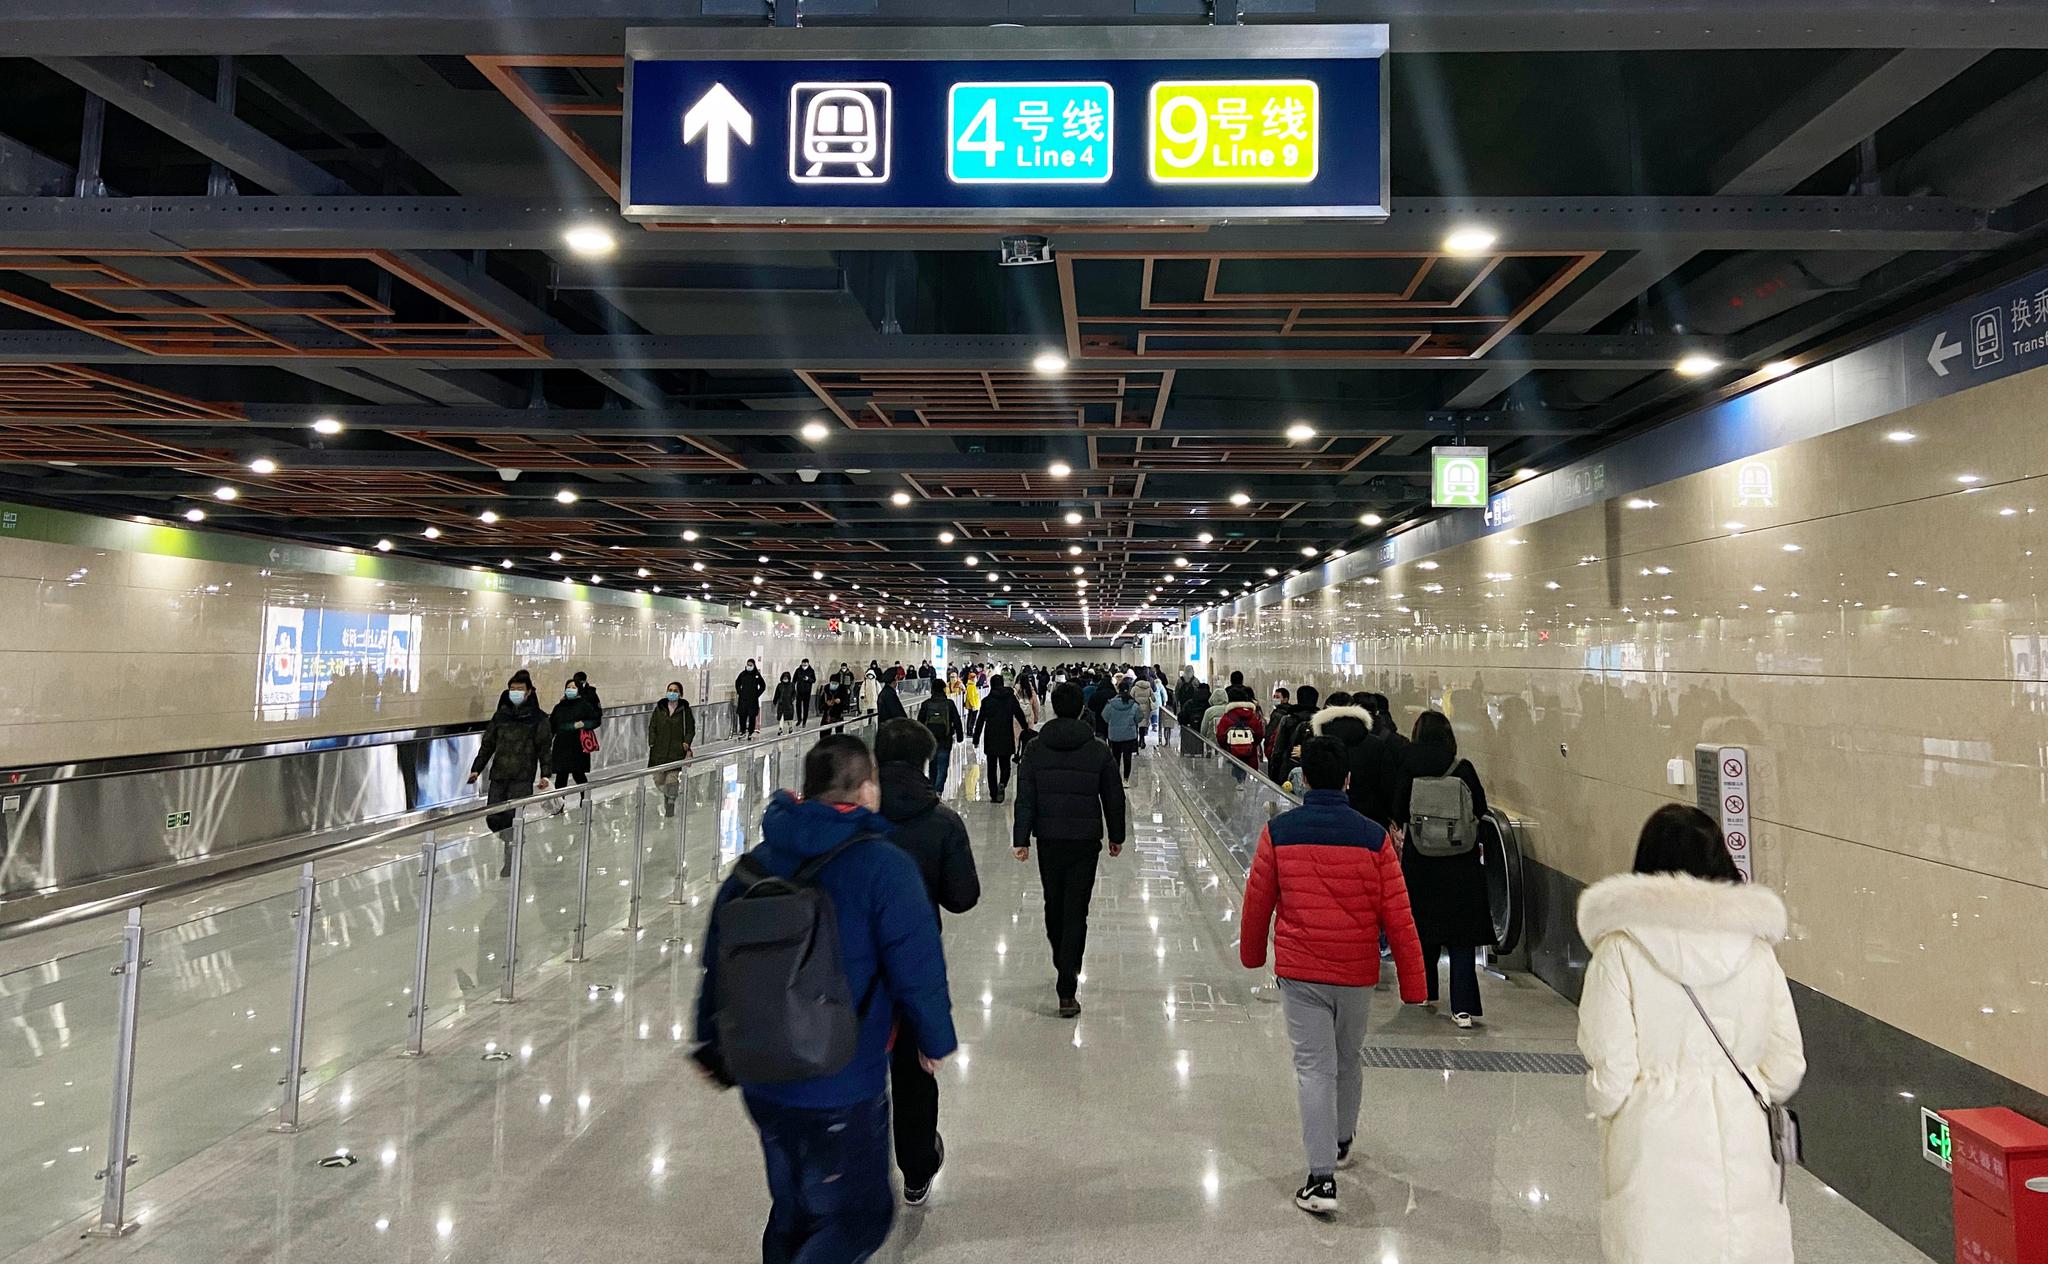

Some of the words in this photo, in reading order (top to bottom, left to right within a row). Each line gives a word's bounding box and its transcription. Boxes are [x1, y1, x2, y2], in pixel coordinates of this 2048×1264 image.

[1017, 145, 1076, 167] Line
[1080, 145, 1095, 167] 4
[1212, 144, 1275, 167] Line
[1282, 143, 1299, 167] 9
